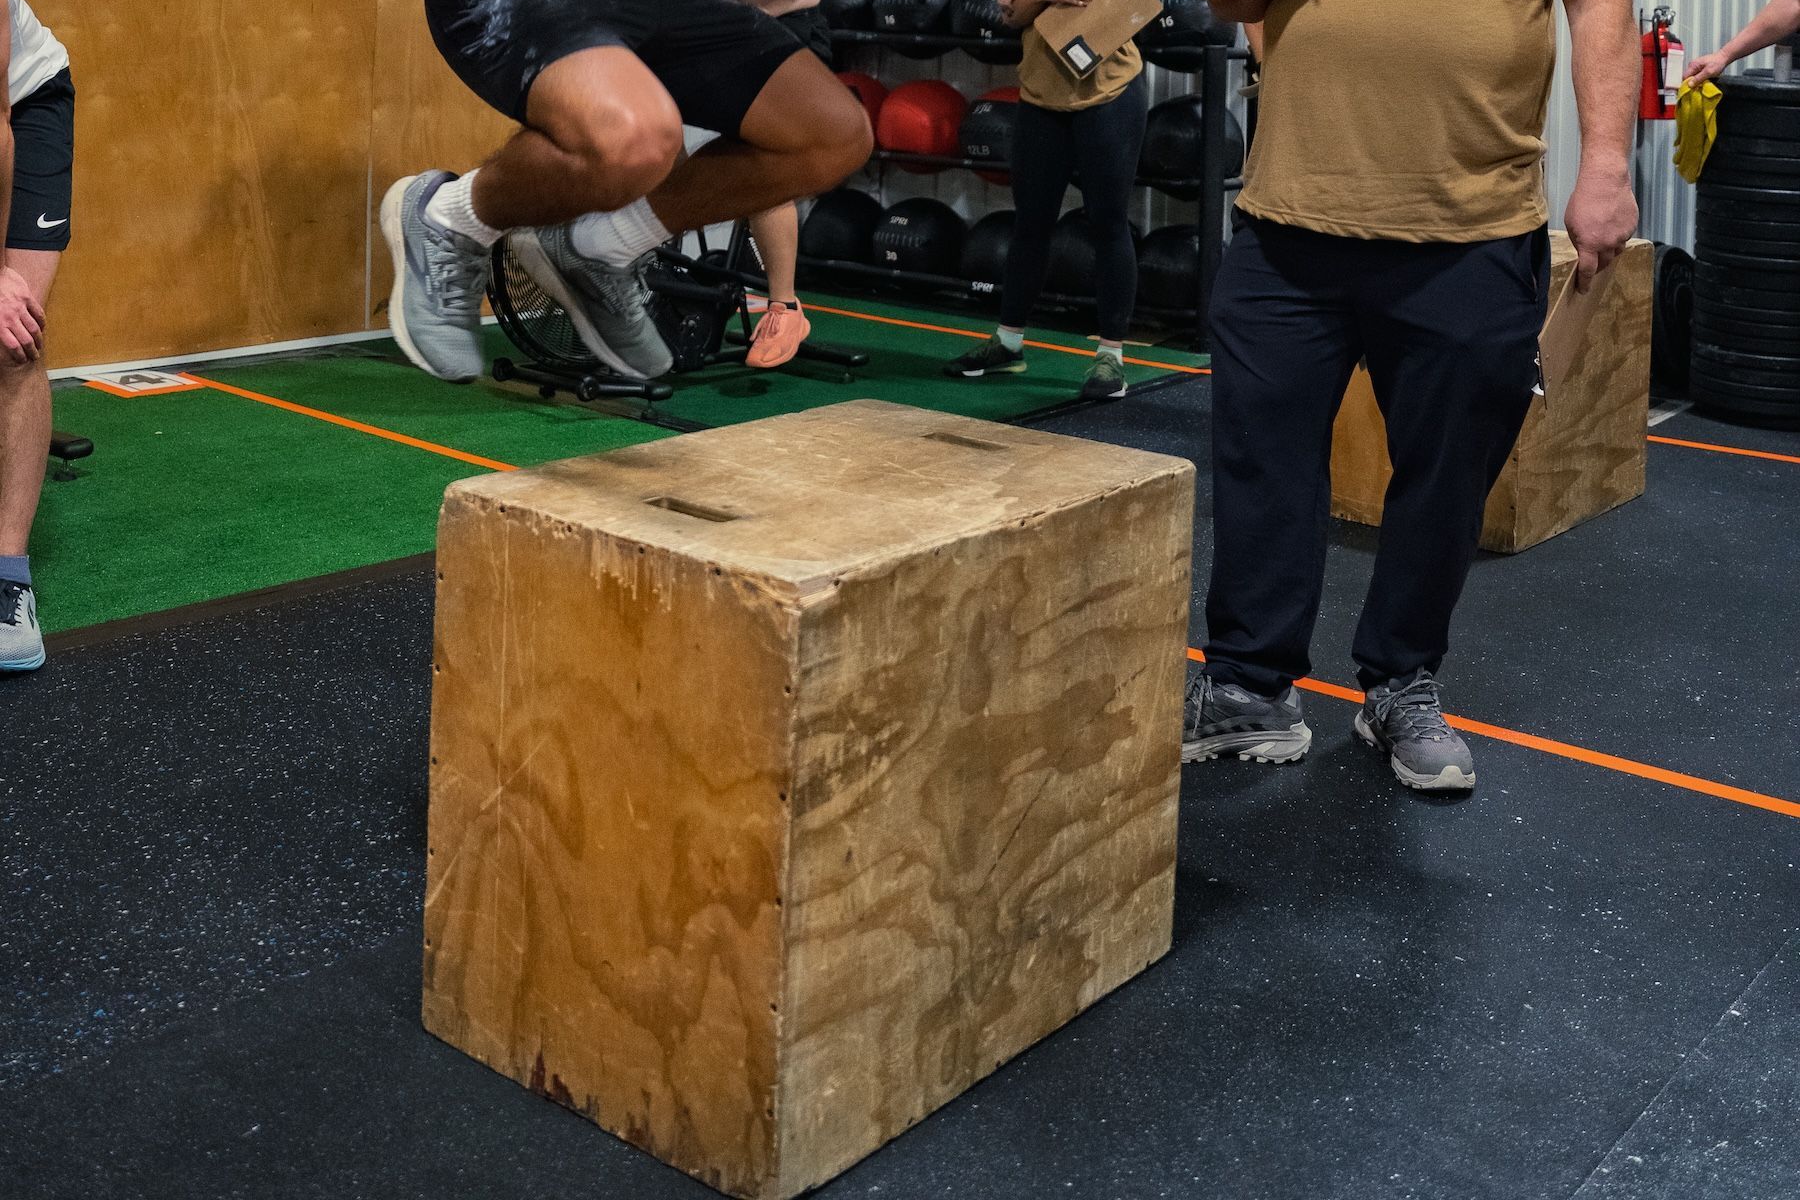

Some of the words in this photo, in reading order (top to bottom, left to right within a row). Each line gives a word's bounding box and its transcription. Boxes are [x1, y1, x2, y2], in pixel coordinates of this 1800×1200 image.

[884, 14, 896, 26] 16
[1160, 15, 1174, 28] 16
[980, 28, 993, 39] 16
[889, 215, 909, 226] SPRI
[971, 281, 995, 293] SPRI
[119, 373, 166, 385] 4
